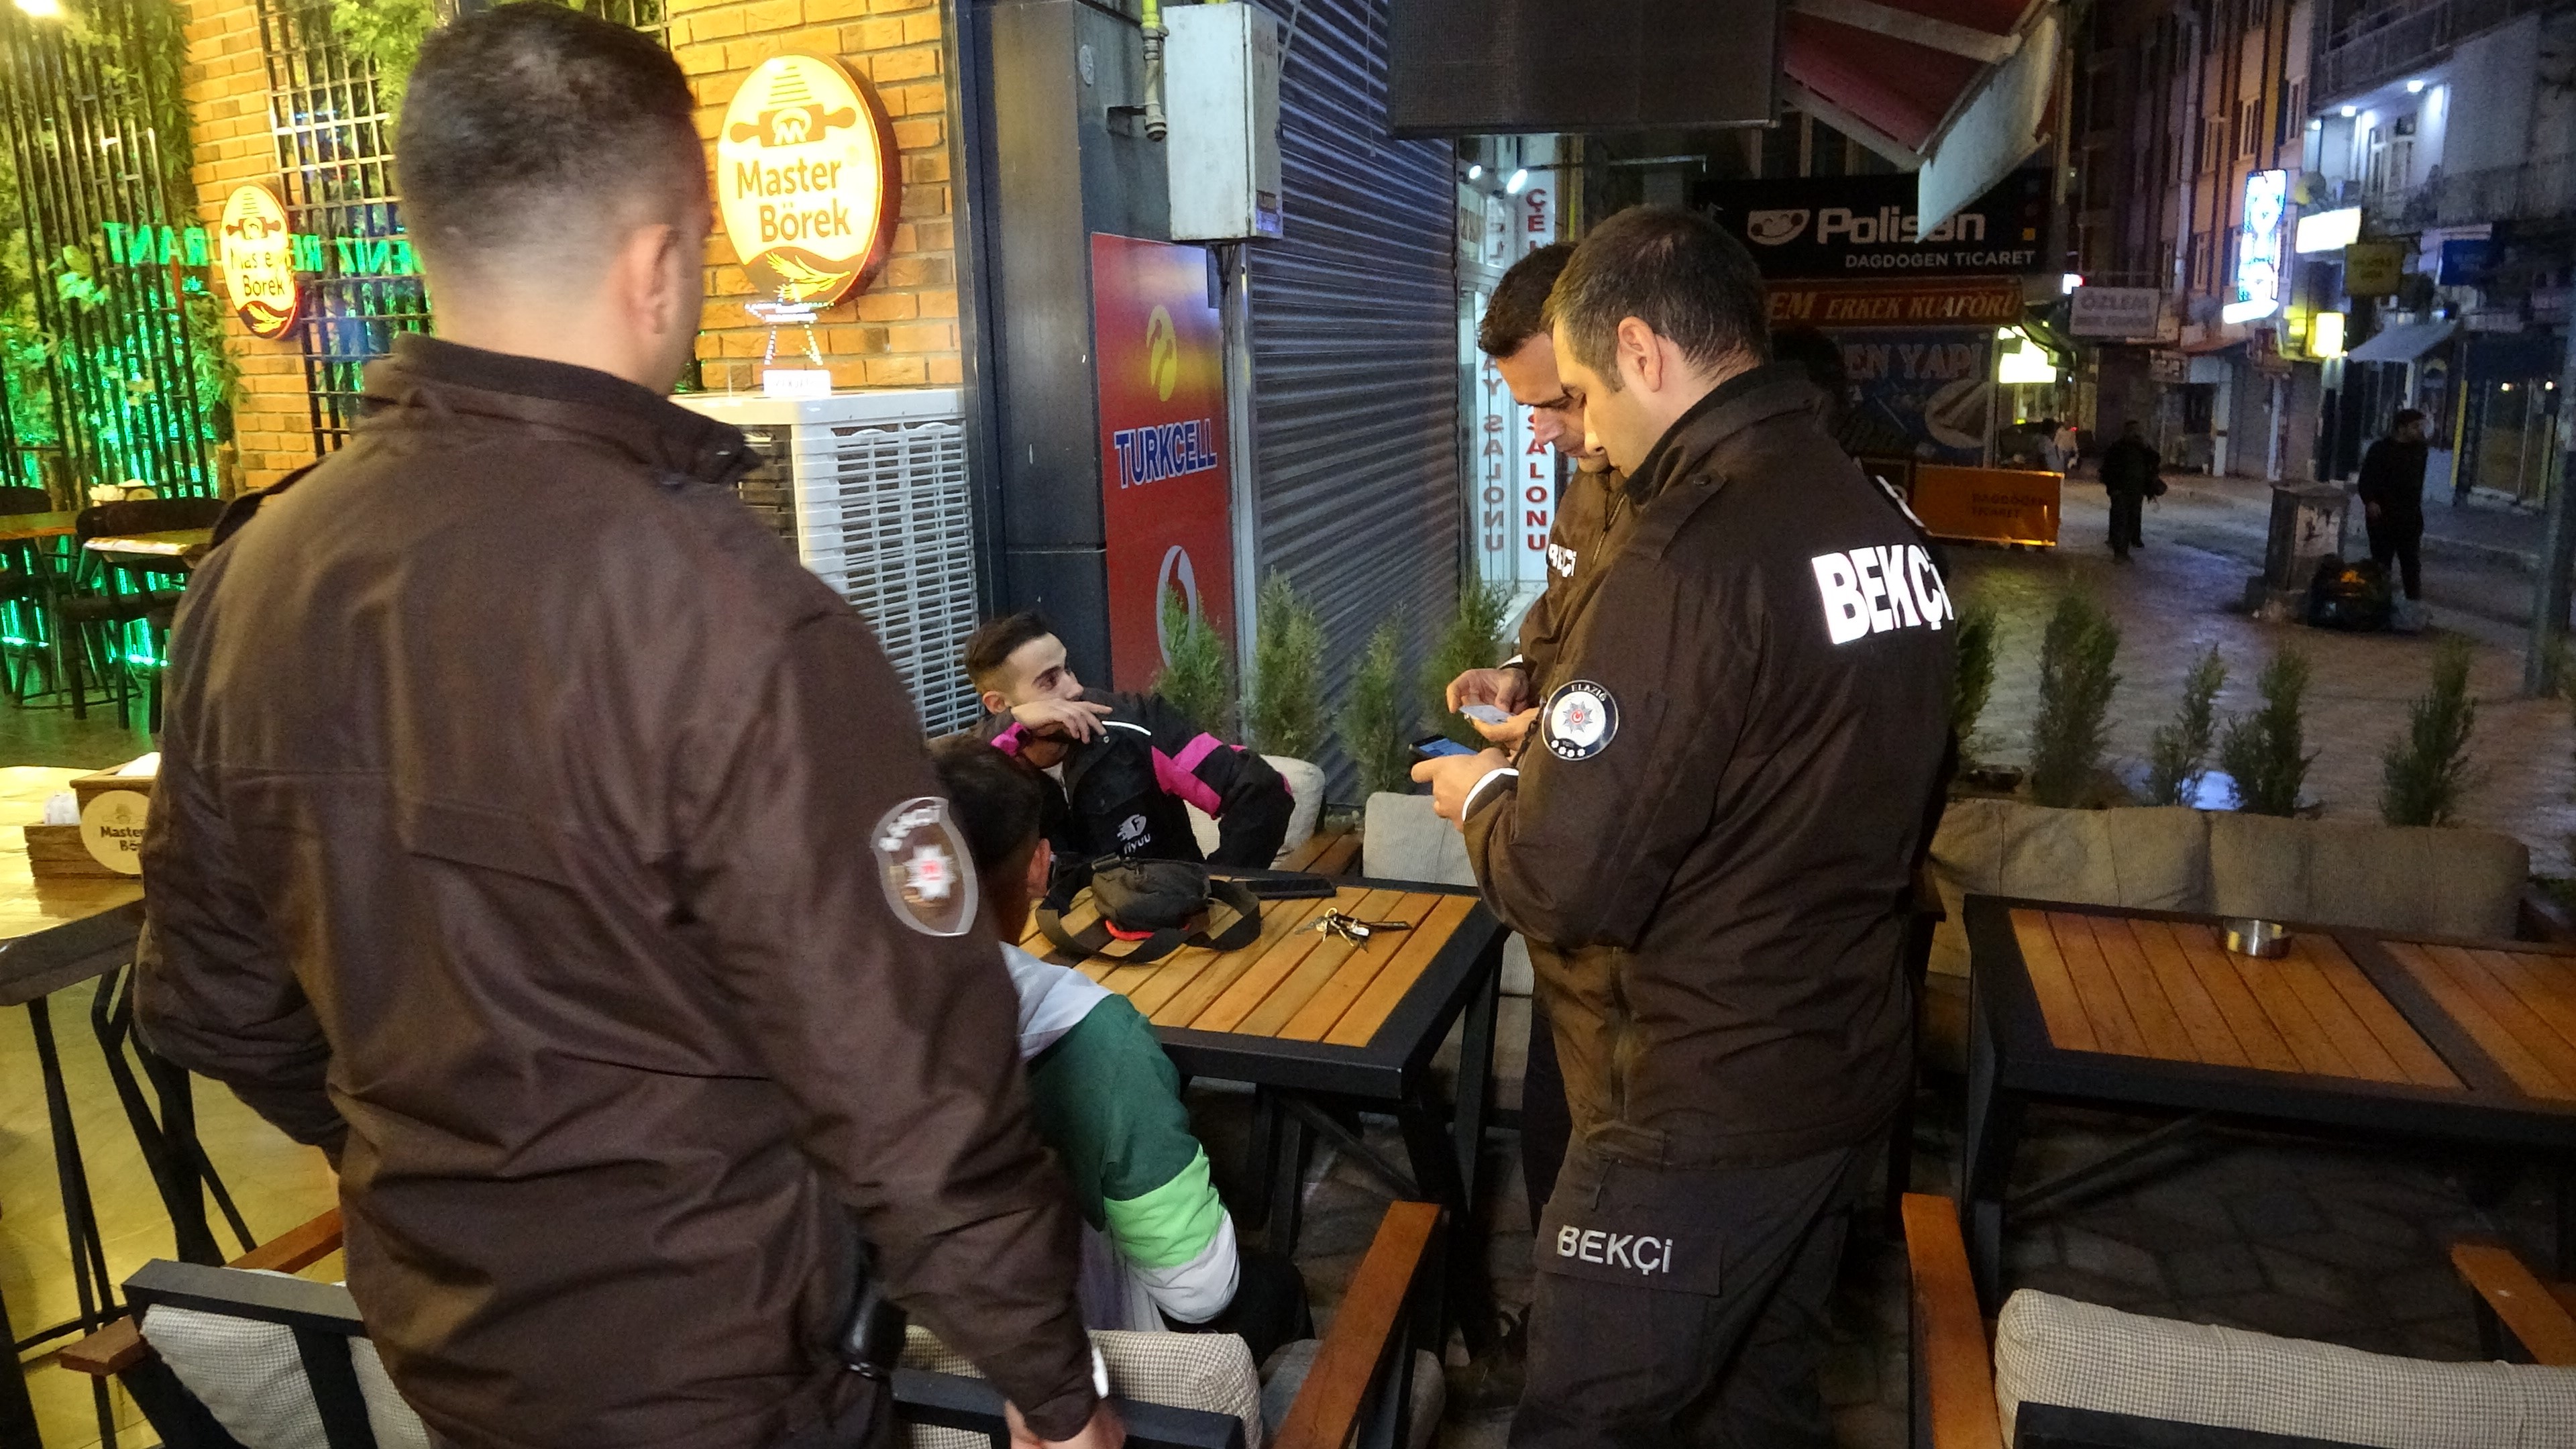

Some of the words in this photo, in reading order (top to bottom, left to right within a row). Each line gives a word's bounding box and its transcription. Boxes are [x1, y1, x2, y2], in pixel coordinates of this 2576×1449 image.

[737, 158, 841, 199] Master
[759, 198, 851, 242] Börek
[1768, 291, 1819, 320] EM
[1825, 297, 1904, 319] ERKEK
[1844, 343, 1891, 380] EN
[1114, 418, 1218, 490] TURKCELL
[1556, 1224, 1673, 1275] BEKÇİ
